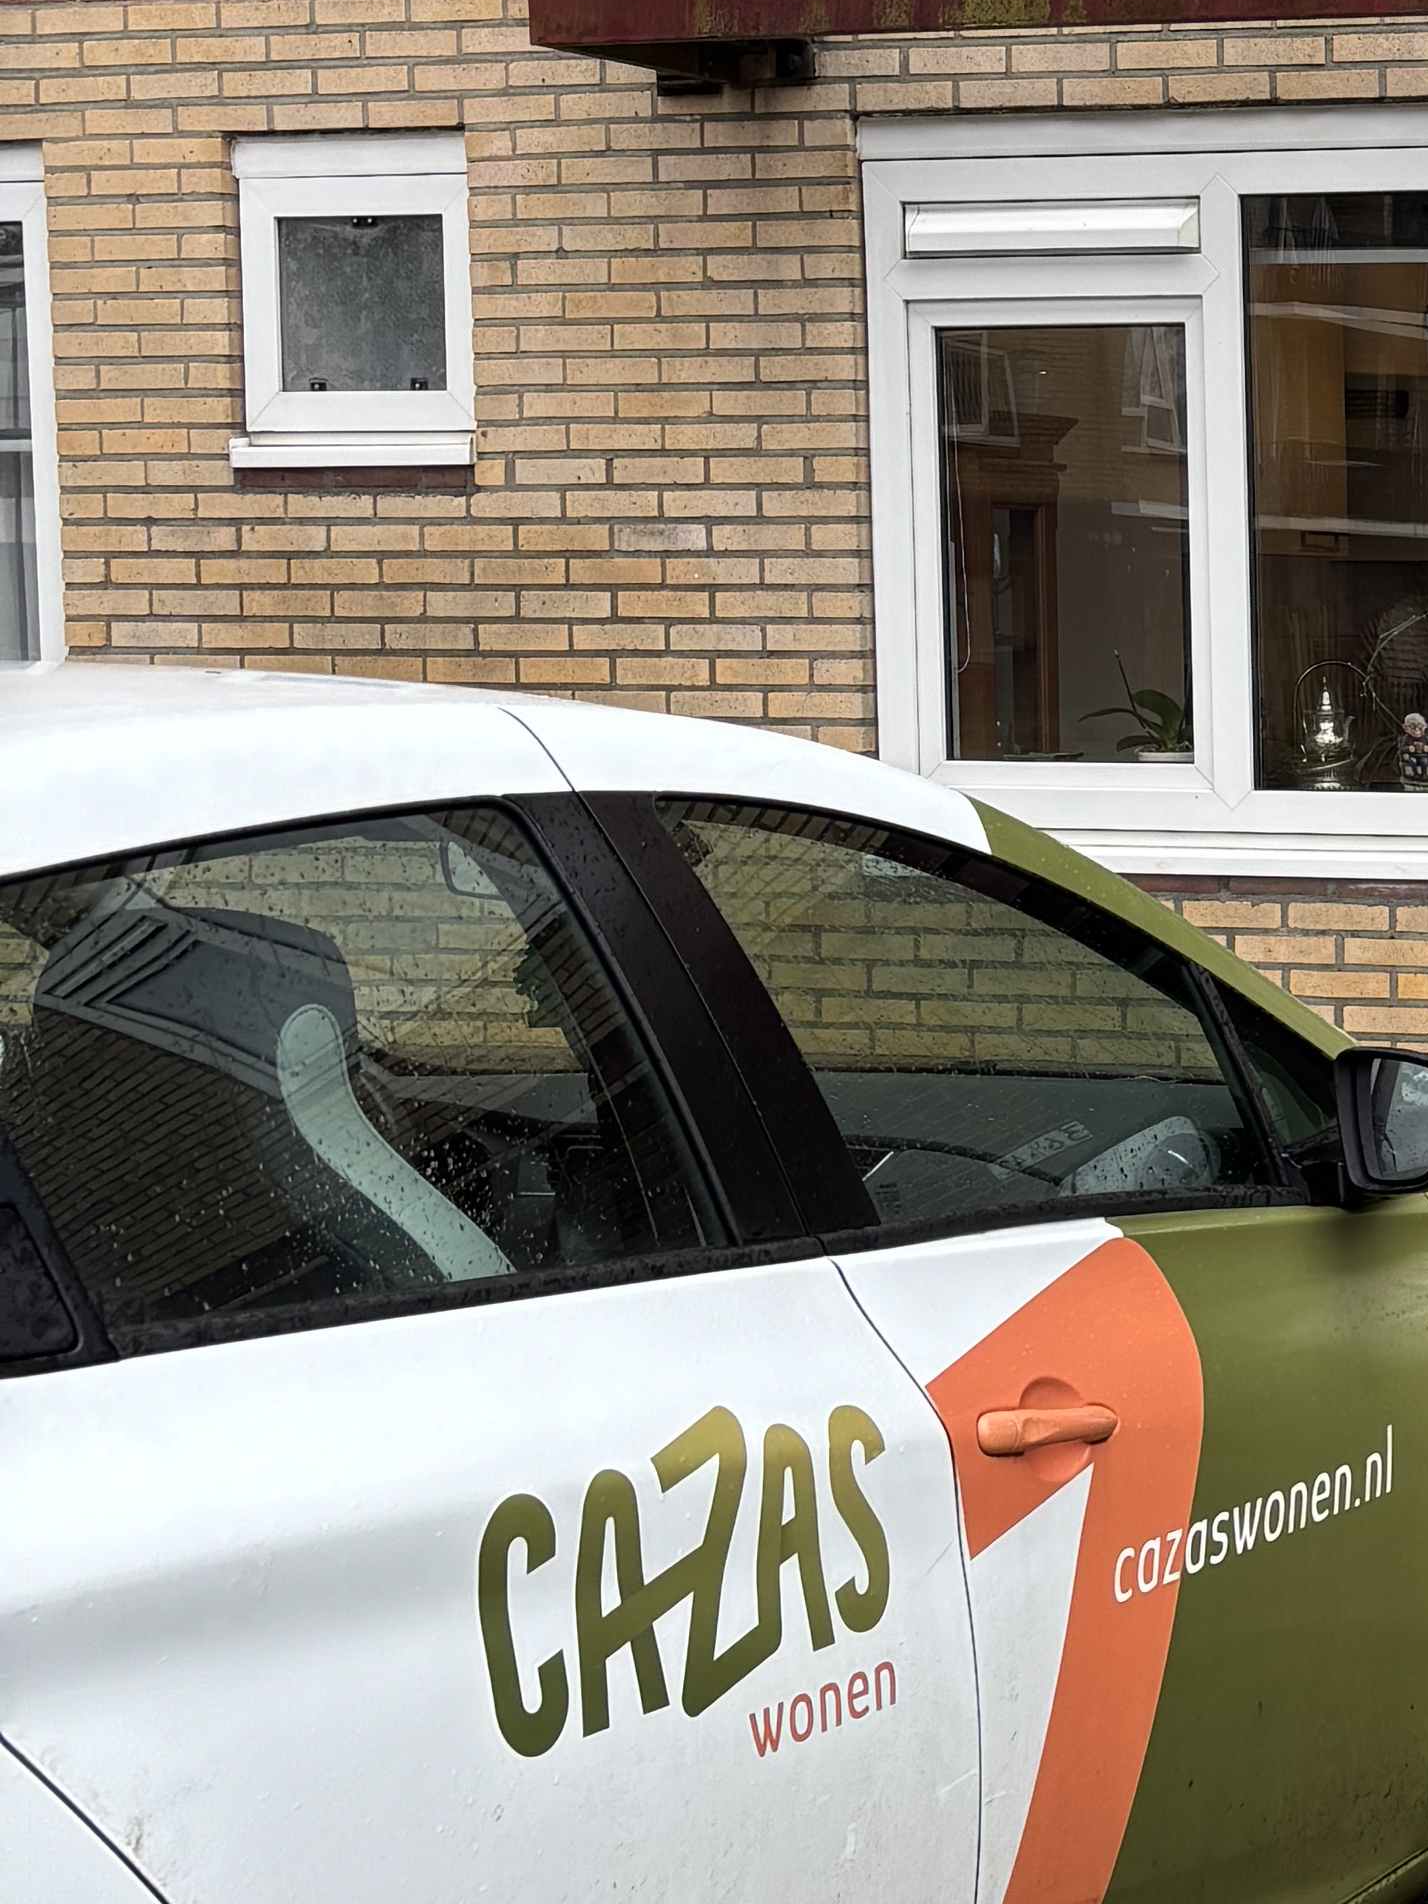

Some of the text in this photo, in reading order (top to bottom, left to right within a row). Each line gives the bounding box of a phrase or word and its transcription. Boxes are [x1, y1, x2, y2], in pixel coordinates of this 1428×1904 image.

[478, 1404, 891, 1758] CAZAS
[1113, 1424, 1393, 1603] cazaswonen.nl
[748, 1658, 897, 1758] wonen
